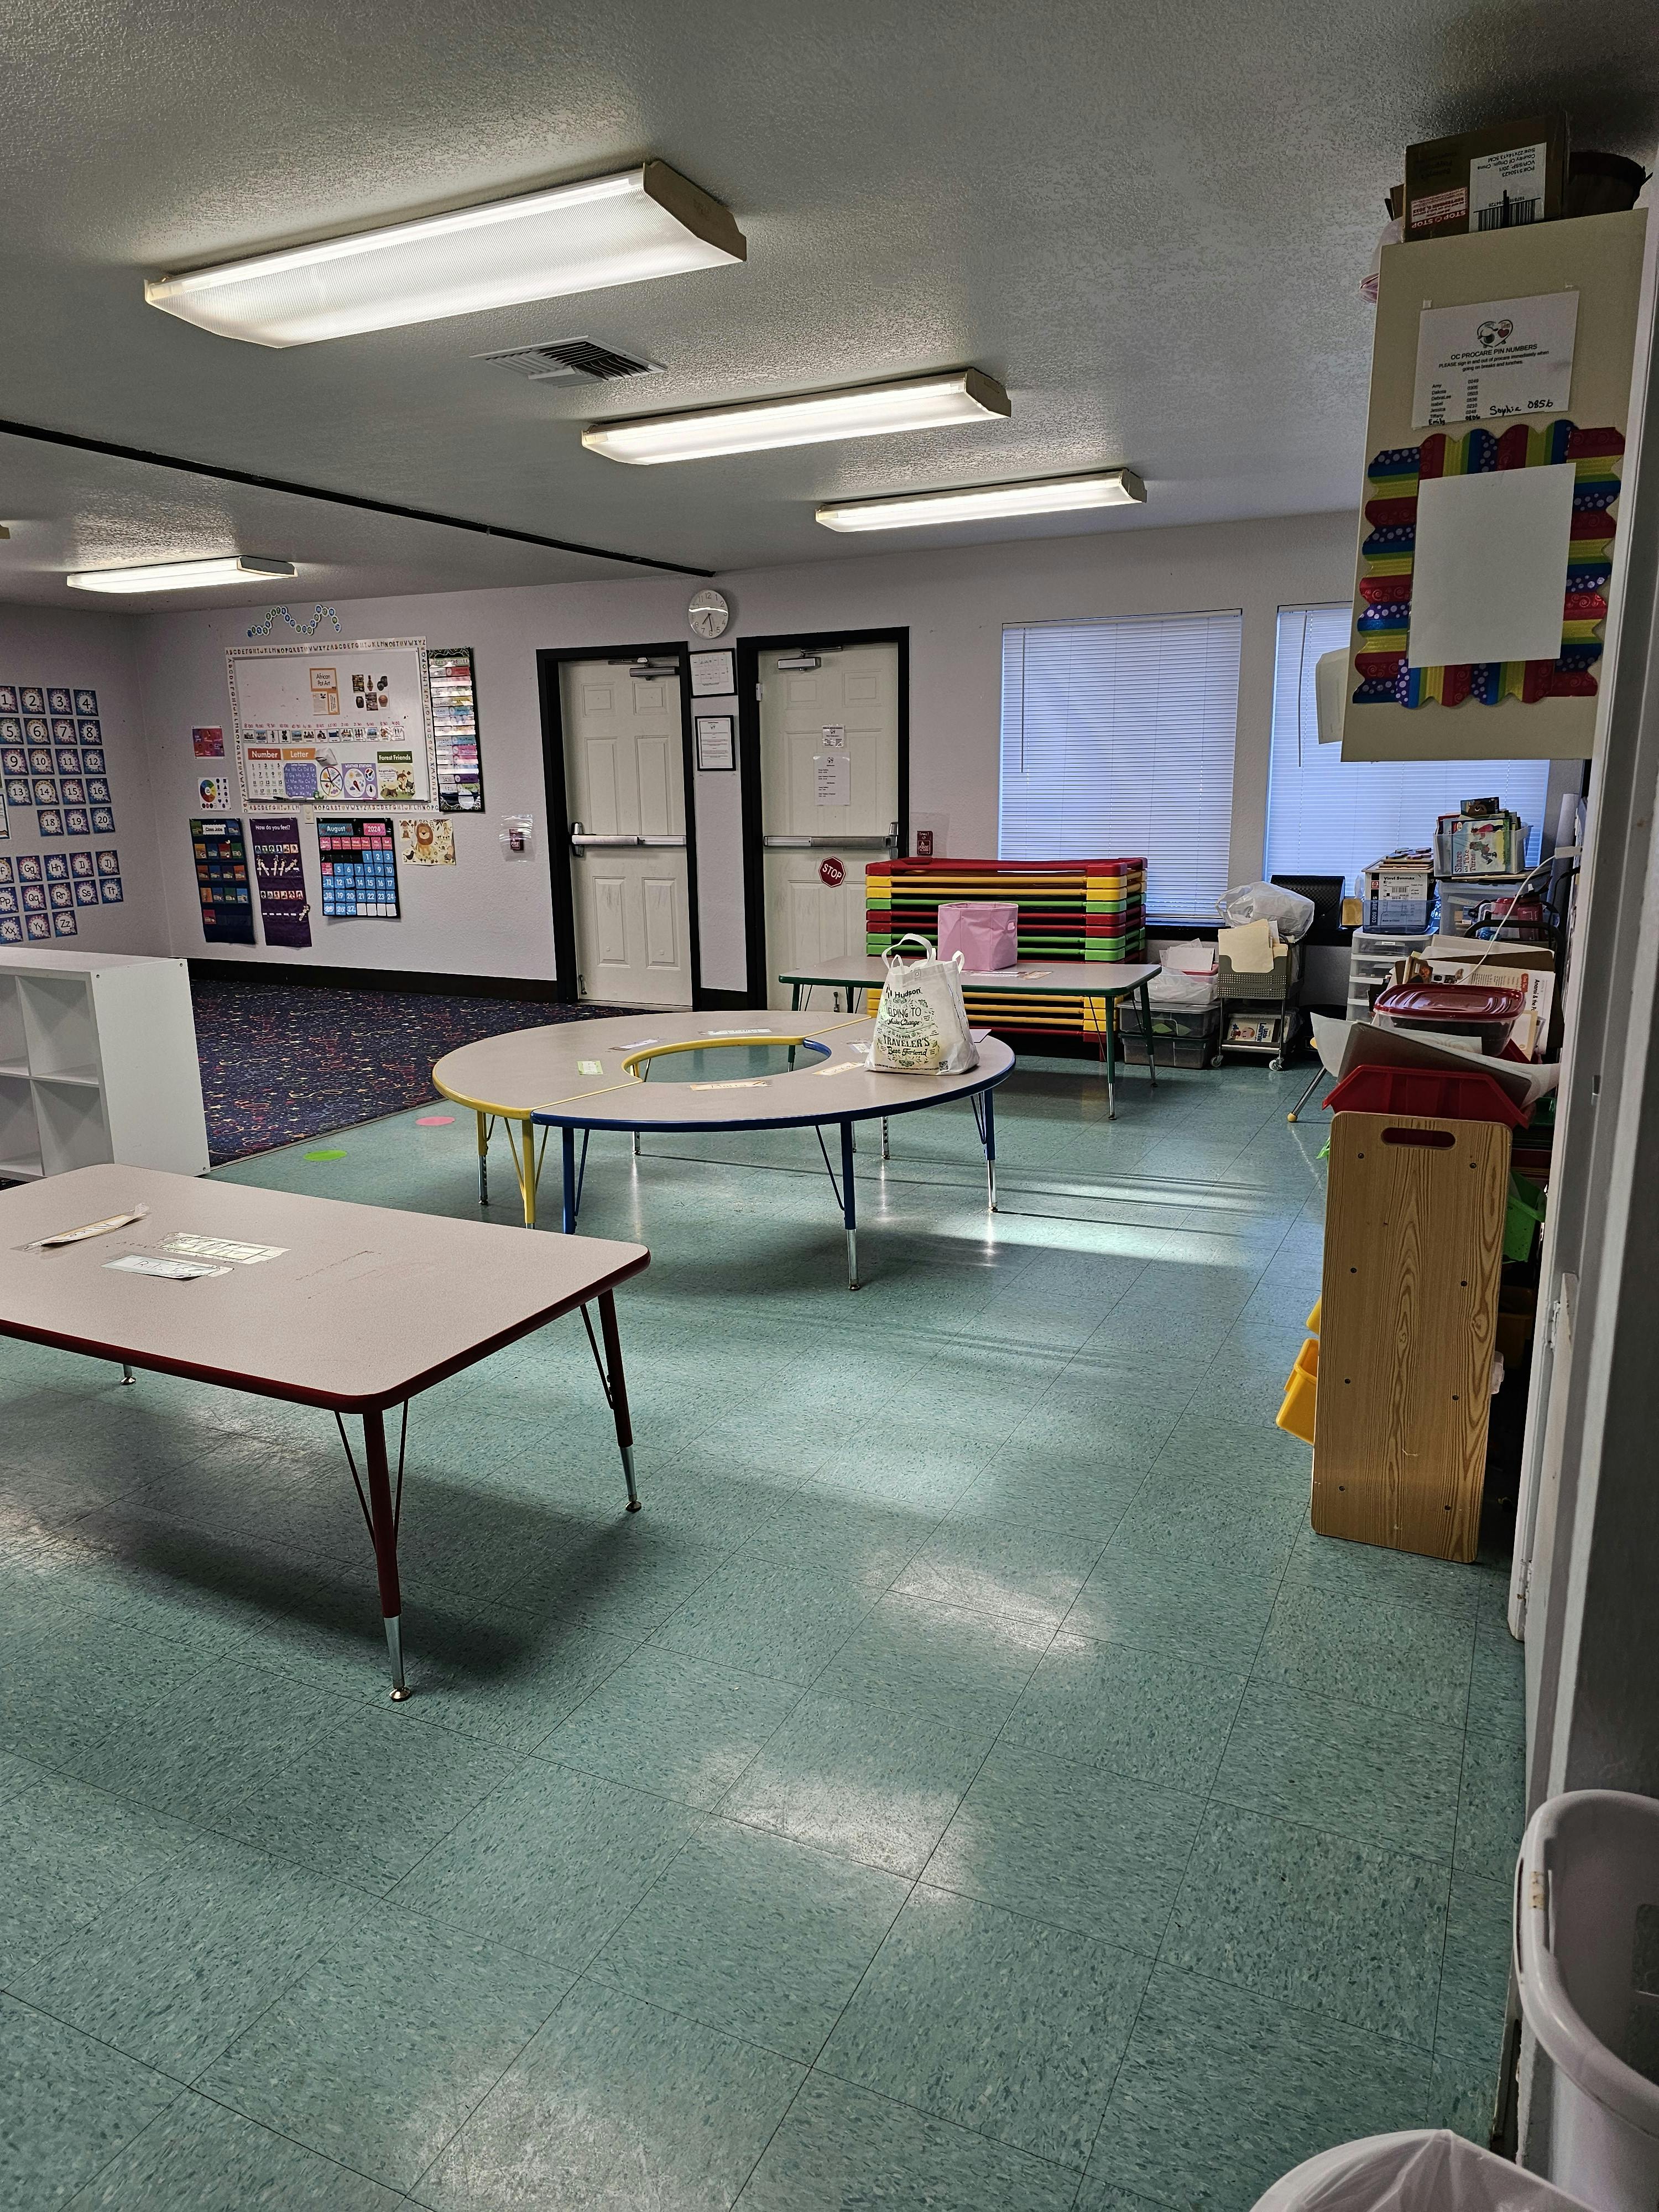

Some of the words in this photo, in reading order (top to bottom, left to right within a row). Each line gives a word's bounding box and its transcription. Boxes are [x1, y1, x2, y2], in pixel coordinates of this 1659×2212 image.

[1444, 210, 1466, 220] STOP
[1411, 218, 1433, 228] STOP
[1462, 349, 1493, 359] PROCARE
[1506, 344, 1538, 353] NUMBERS
[2, 694, 9, 705] 1
[29, 695, 36, 706] 2
[56, 696, 64, 707] 3
[82, 698, 91, 709] 4
[7, 726, 13, 737] 5
[34, 726, 41, 737] 6
[60, 727, 67, 737] 7
[87, 727, 93, 738] 8
[11, 756, 18, 767] 9
[24, 864, 34, 874] Gg
[105, 859, 112, 869] Jj
[822, 863, 842, 880] STOP
[107, 886, 116, 895] Tt
[29, 894, 40, 904] Qq
[33, 922, 43, 931] Yy
[60, 919, 71, 928] Zz
[4, 926, 15, 935] Xx
[895, 988, 921, 998] Hudson
[911, 1007, 921, 1016] TO
[900, 1018, 920, 1027] Change
[883, 1035, 930, 1047] TRAVELER'S
[887, 1046, 901, 1055] Best
[902, 1048, 928, 1057] Friend
